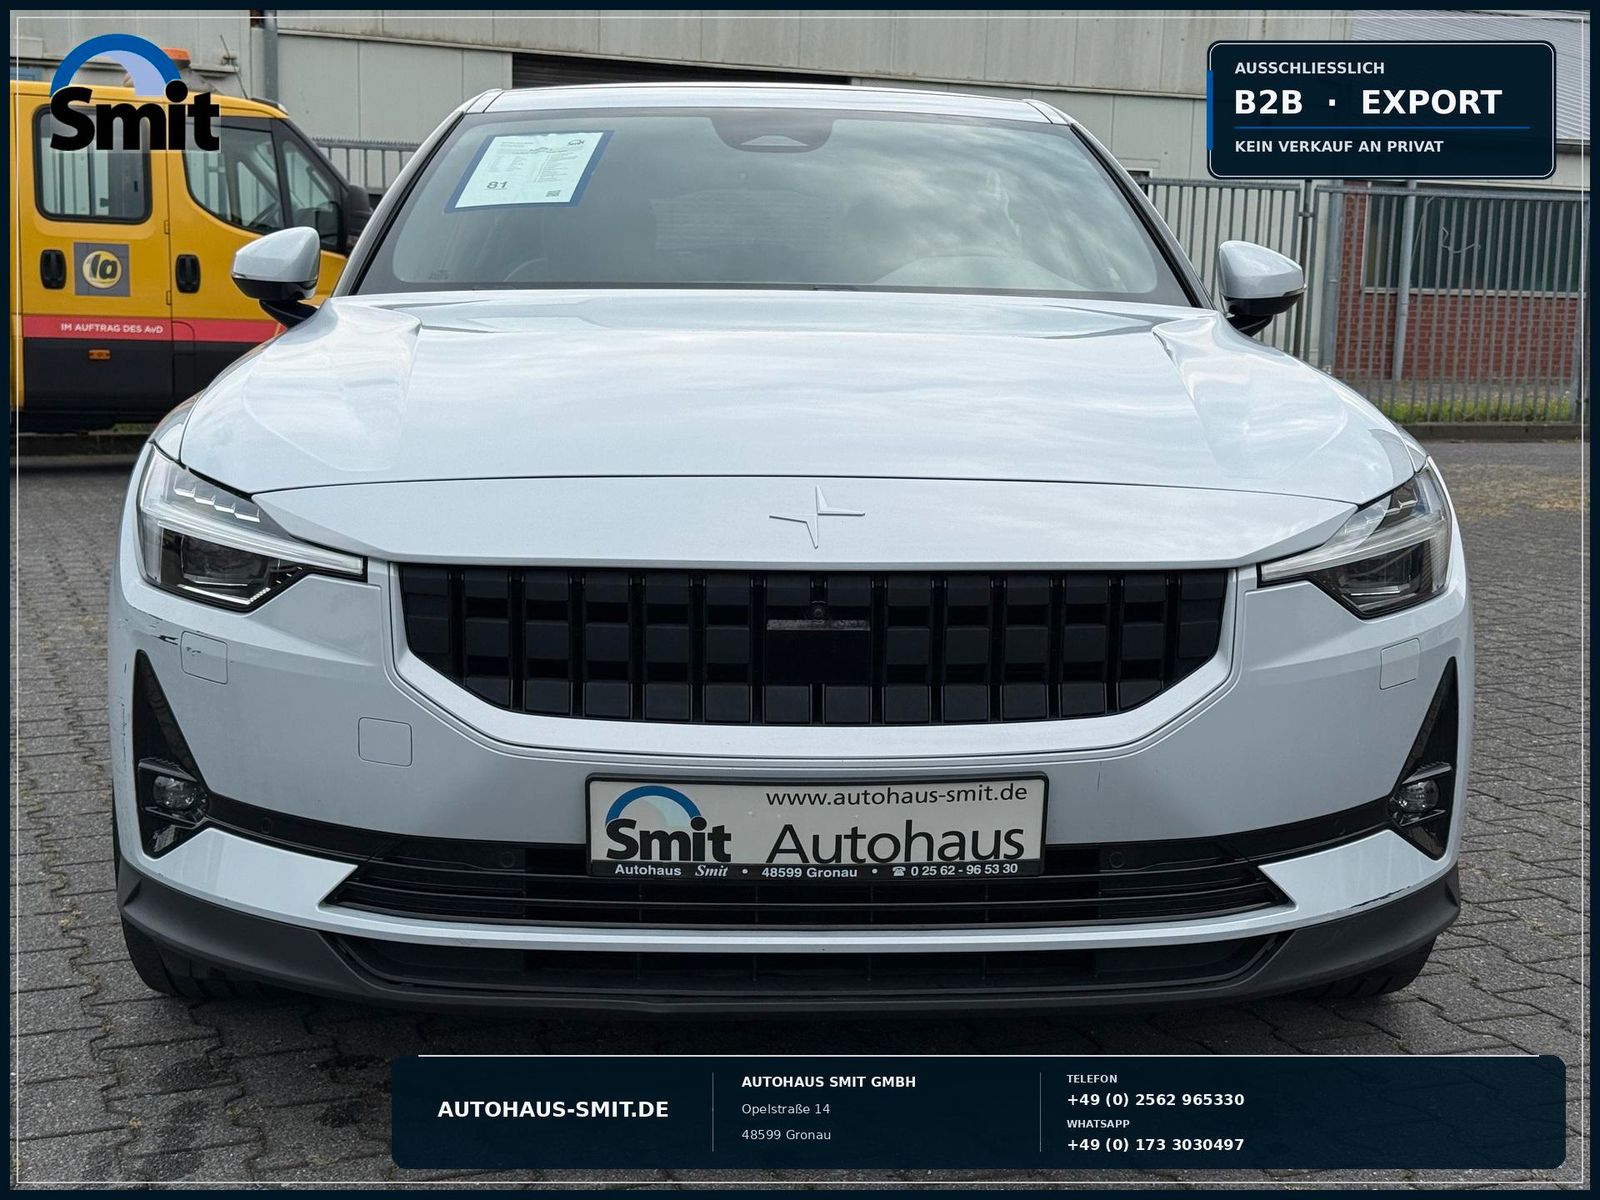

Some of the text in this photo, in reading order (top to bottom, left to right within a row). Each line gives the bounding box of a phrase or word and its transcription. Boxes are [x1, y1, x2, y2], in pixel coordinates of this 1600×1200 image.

[487, 181, 508, 189] 81
[61, 323, 72, 332] IM
[75, 323, 121, 333] AUFTRAG
[122, 324, 142, 333] DES
[766, 783, 1028, 806] www.autohaus-smit.de
[605, 816, 732, 863] Smit
[765, 819, 1025, 865] Autohaus
[614, 863, 682, 876] Autohaus
[694, 864, 729, 877] Smit
[761, 867, 803, 878] 48599
[806, 866, 858, 878] Gronau
[910, 866, 919, 876] 0
[922, 865, 937, 876] 25
[940, 865, 956, 876] 62
[966, 864, 982, 875] 96
[984, 864, 1000, 875] 53
[1002, 863, 1019, 874] 30
